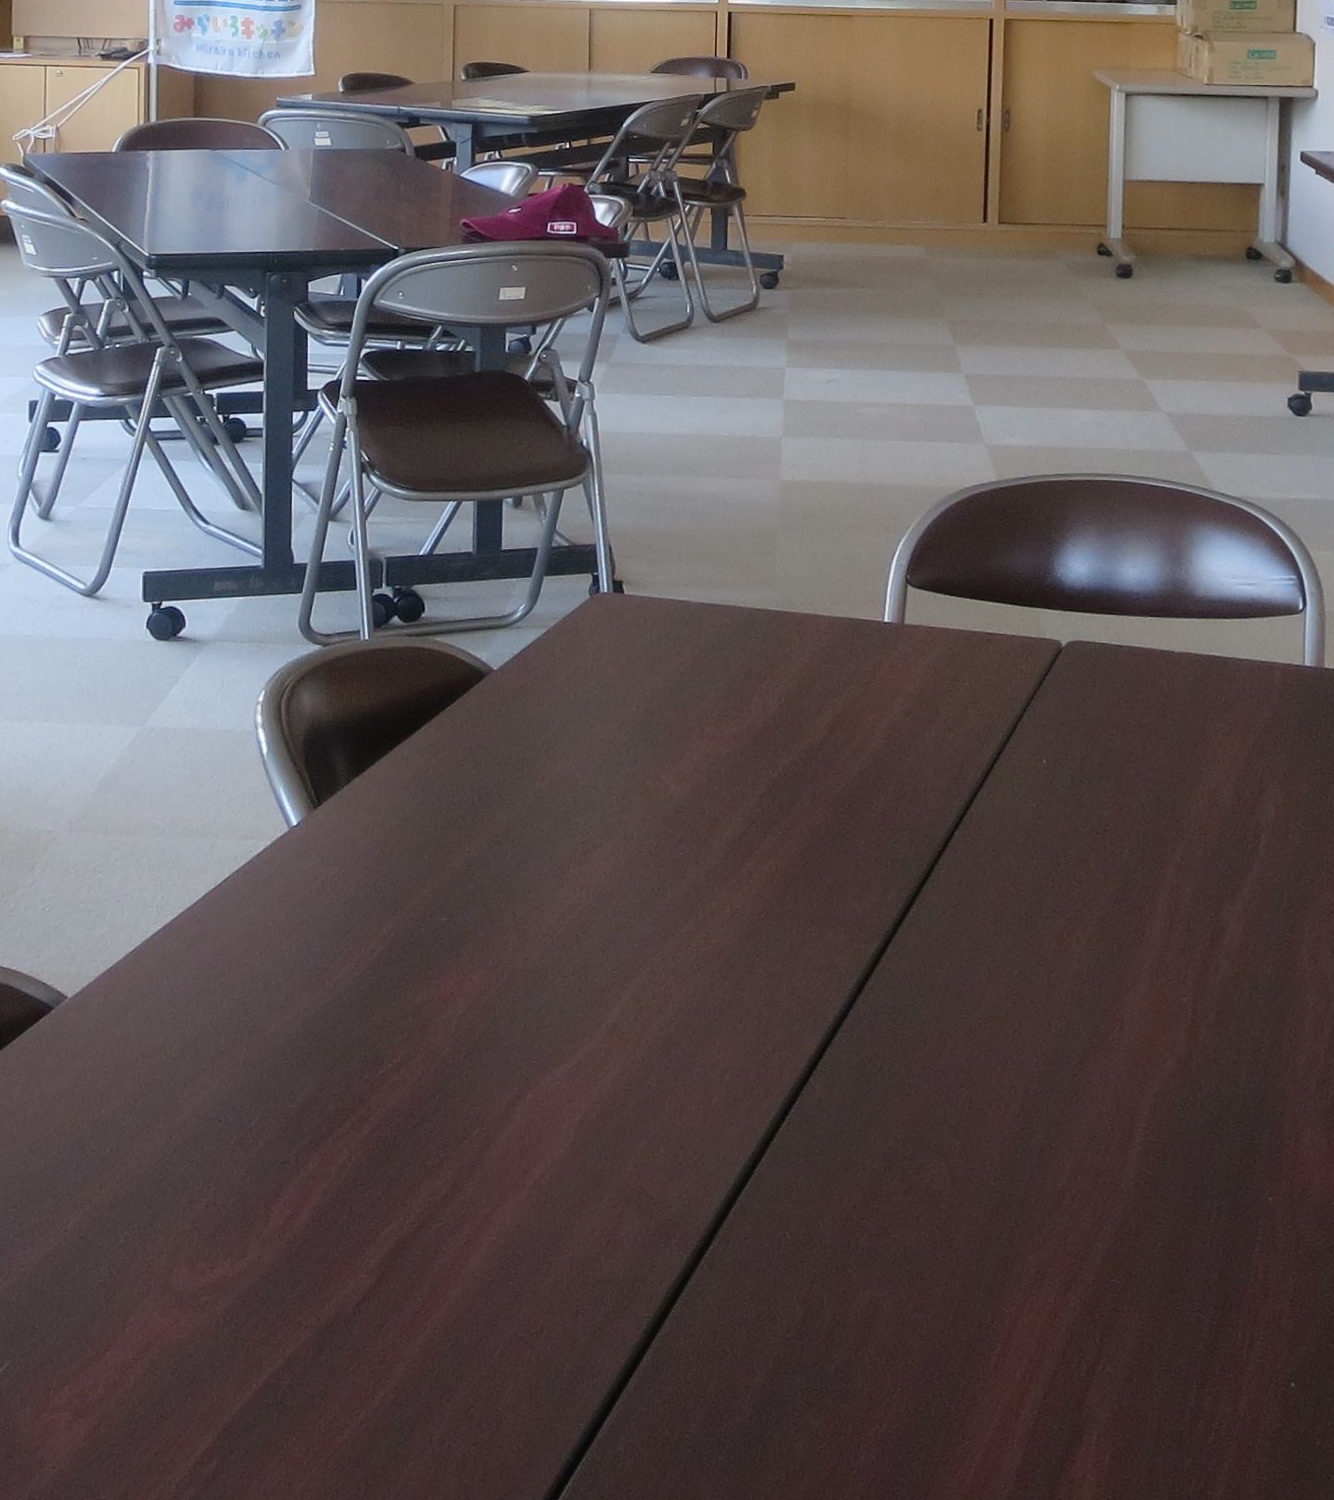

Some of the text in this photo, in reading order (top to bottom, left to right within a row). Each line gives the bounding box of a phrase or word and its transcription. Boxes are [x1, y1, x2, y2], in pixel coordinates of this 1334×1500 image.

[174, 14, 303, 40] みらいろキッチン
